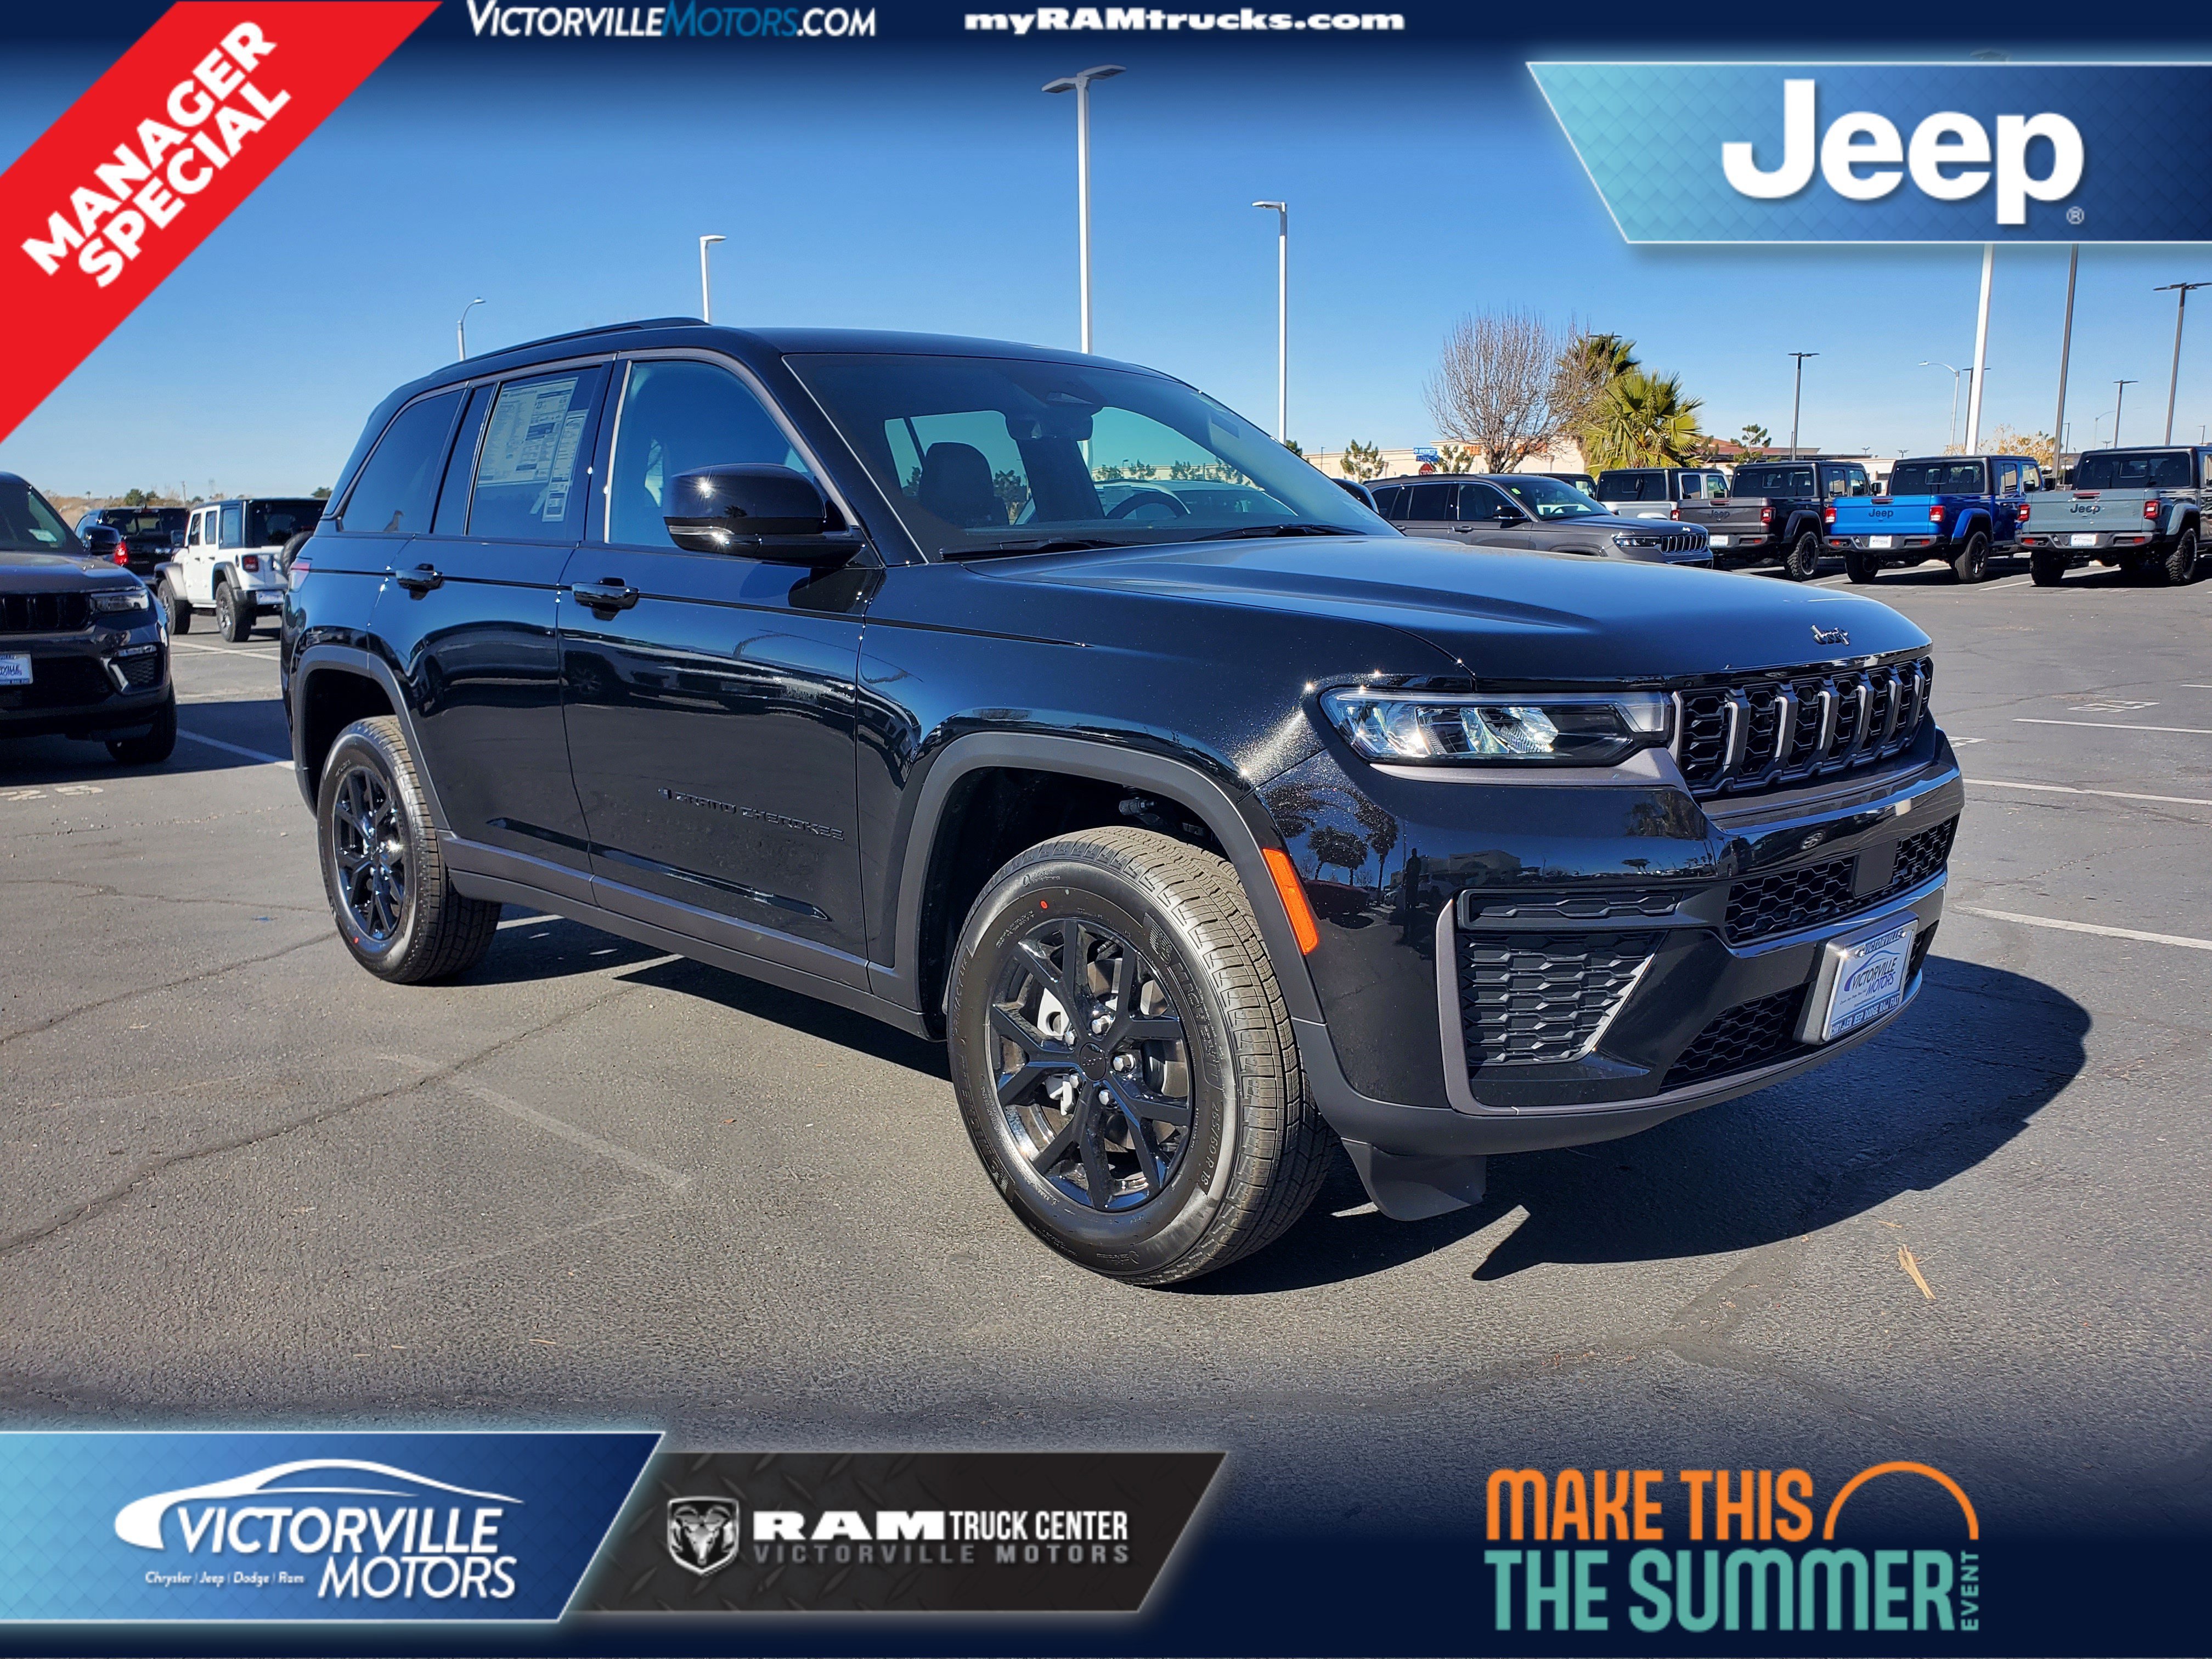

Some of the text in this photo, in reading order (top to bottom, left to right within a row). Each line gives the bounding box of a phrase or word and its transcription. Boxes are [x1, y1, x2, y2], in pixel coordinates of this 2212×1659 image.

[1708, 510, 1730, 519] Jeep
[1868, 508, 1894, 518] Jeep
[2069, 503, 2101, 515] Jeep
[1852, 957, 1898, 991] VICTORVILLE
[1865, 971, 1896, 996] MOTORS
[1853, 1011, 1864, 1025] JEEP
[1209, 1101, 1222, 1154] 265/60
